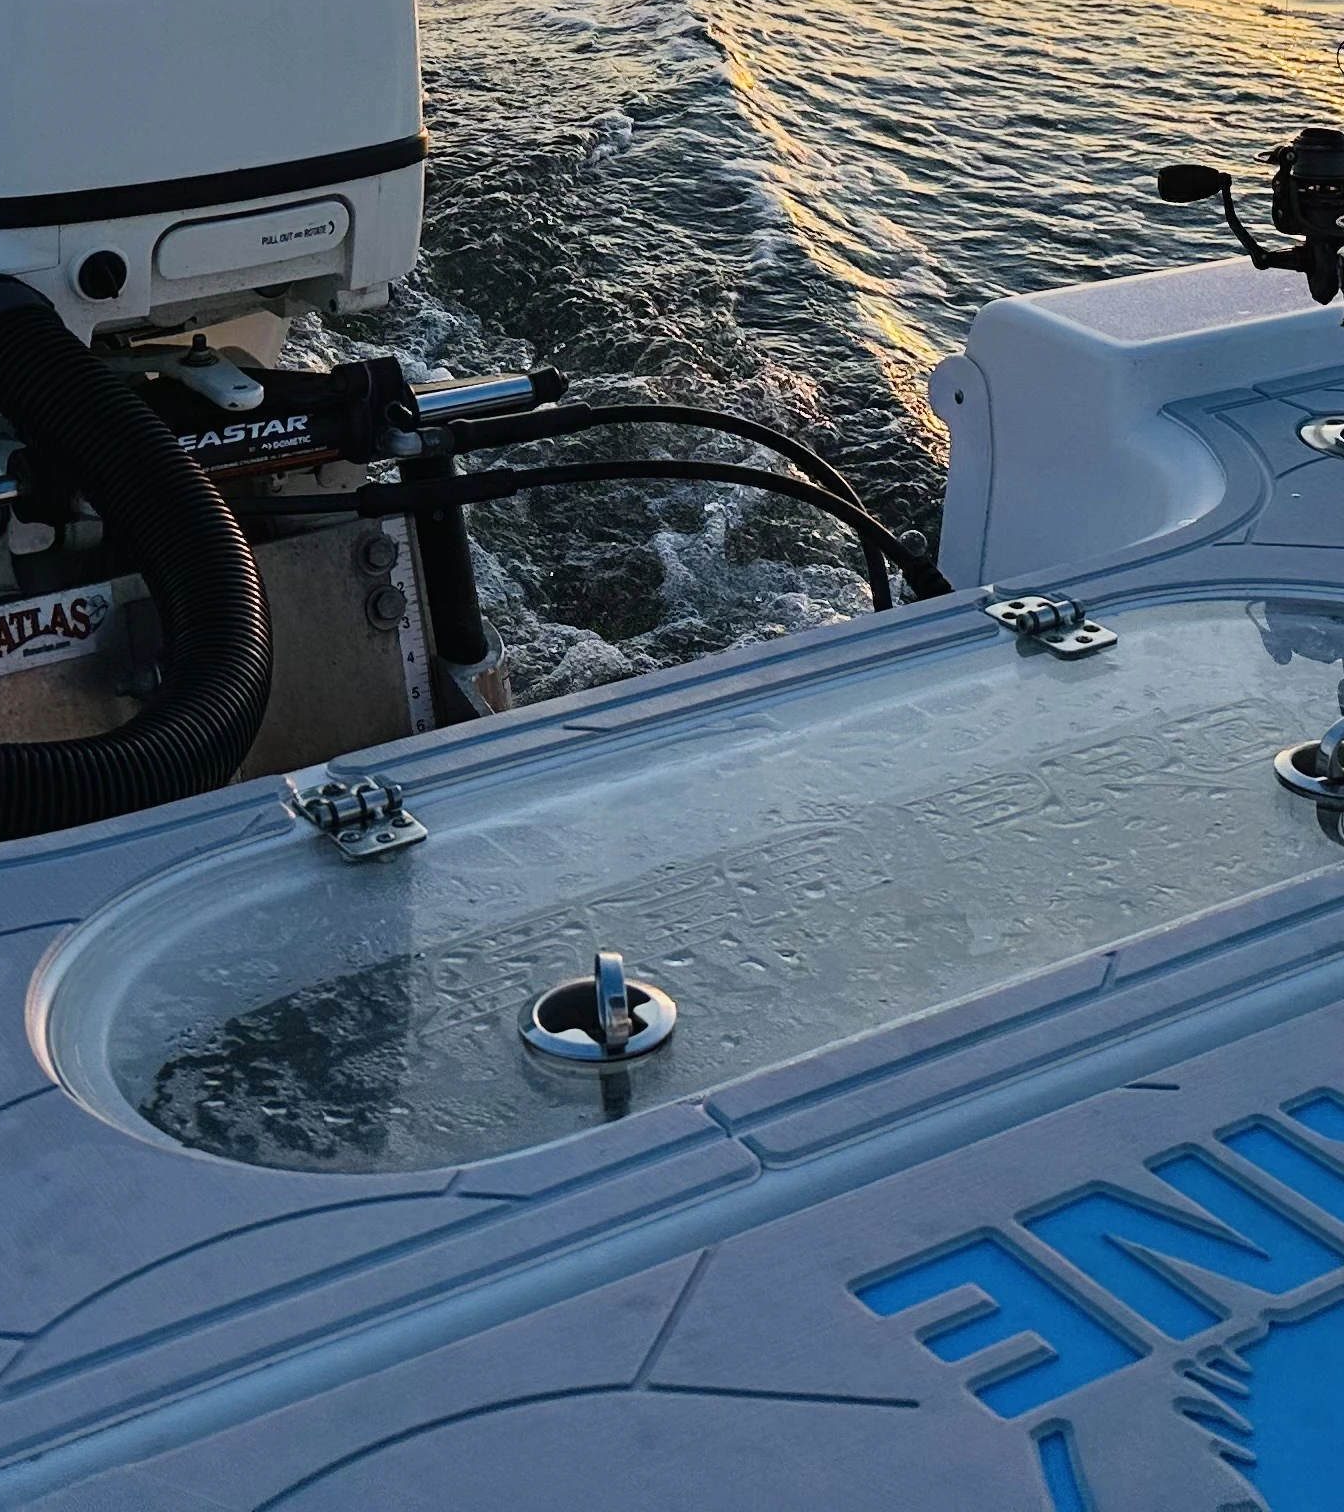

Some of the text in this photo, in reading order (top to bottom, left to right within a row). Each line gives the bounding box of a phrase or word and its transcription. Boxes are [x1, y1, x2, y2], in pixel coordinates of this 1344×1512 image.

[261, 235, 278, 245] PULL
[279, 231, 293, 243] OUT
[304, 224, 327, 238] ROTATE
[176, 414, 309, 452] EASTAR
[273, 434, 312, 450] DOMETIC
[397, 581, 405, 594] 2
[402, 616, 411, 629] 3
[407, 651, 415, 664] 4
[412, 686, 421, 699] 5
[416, 719, 425, 732] 6
